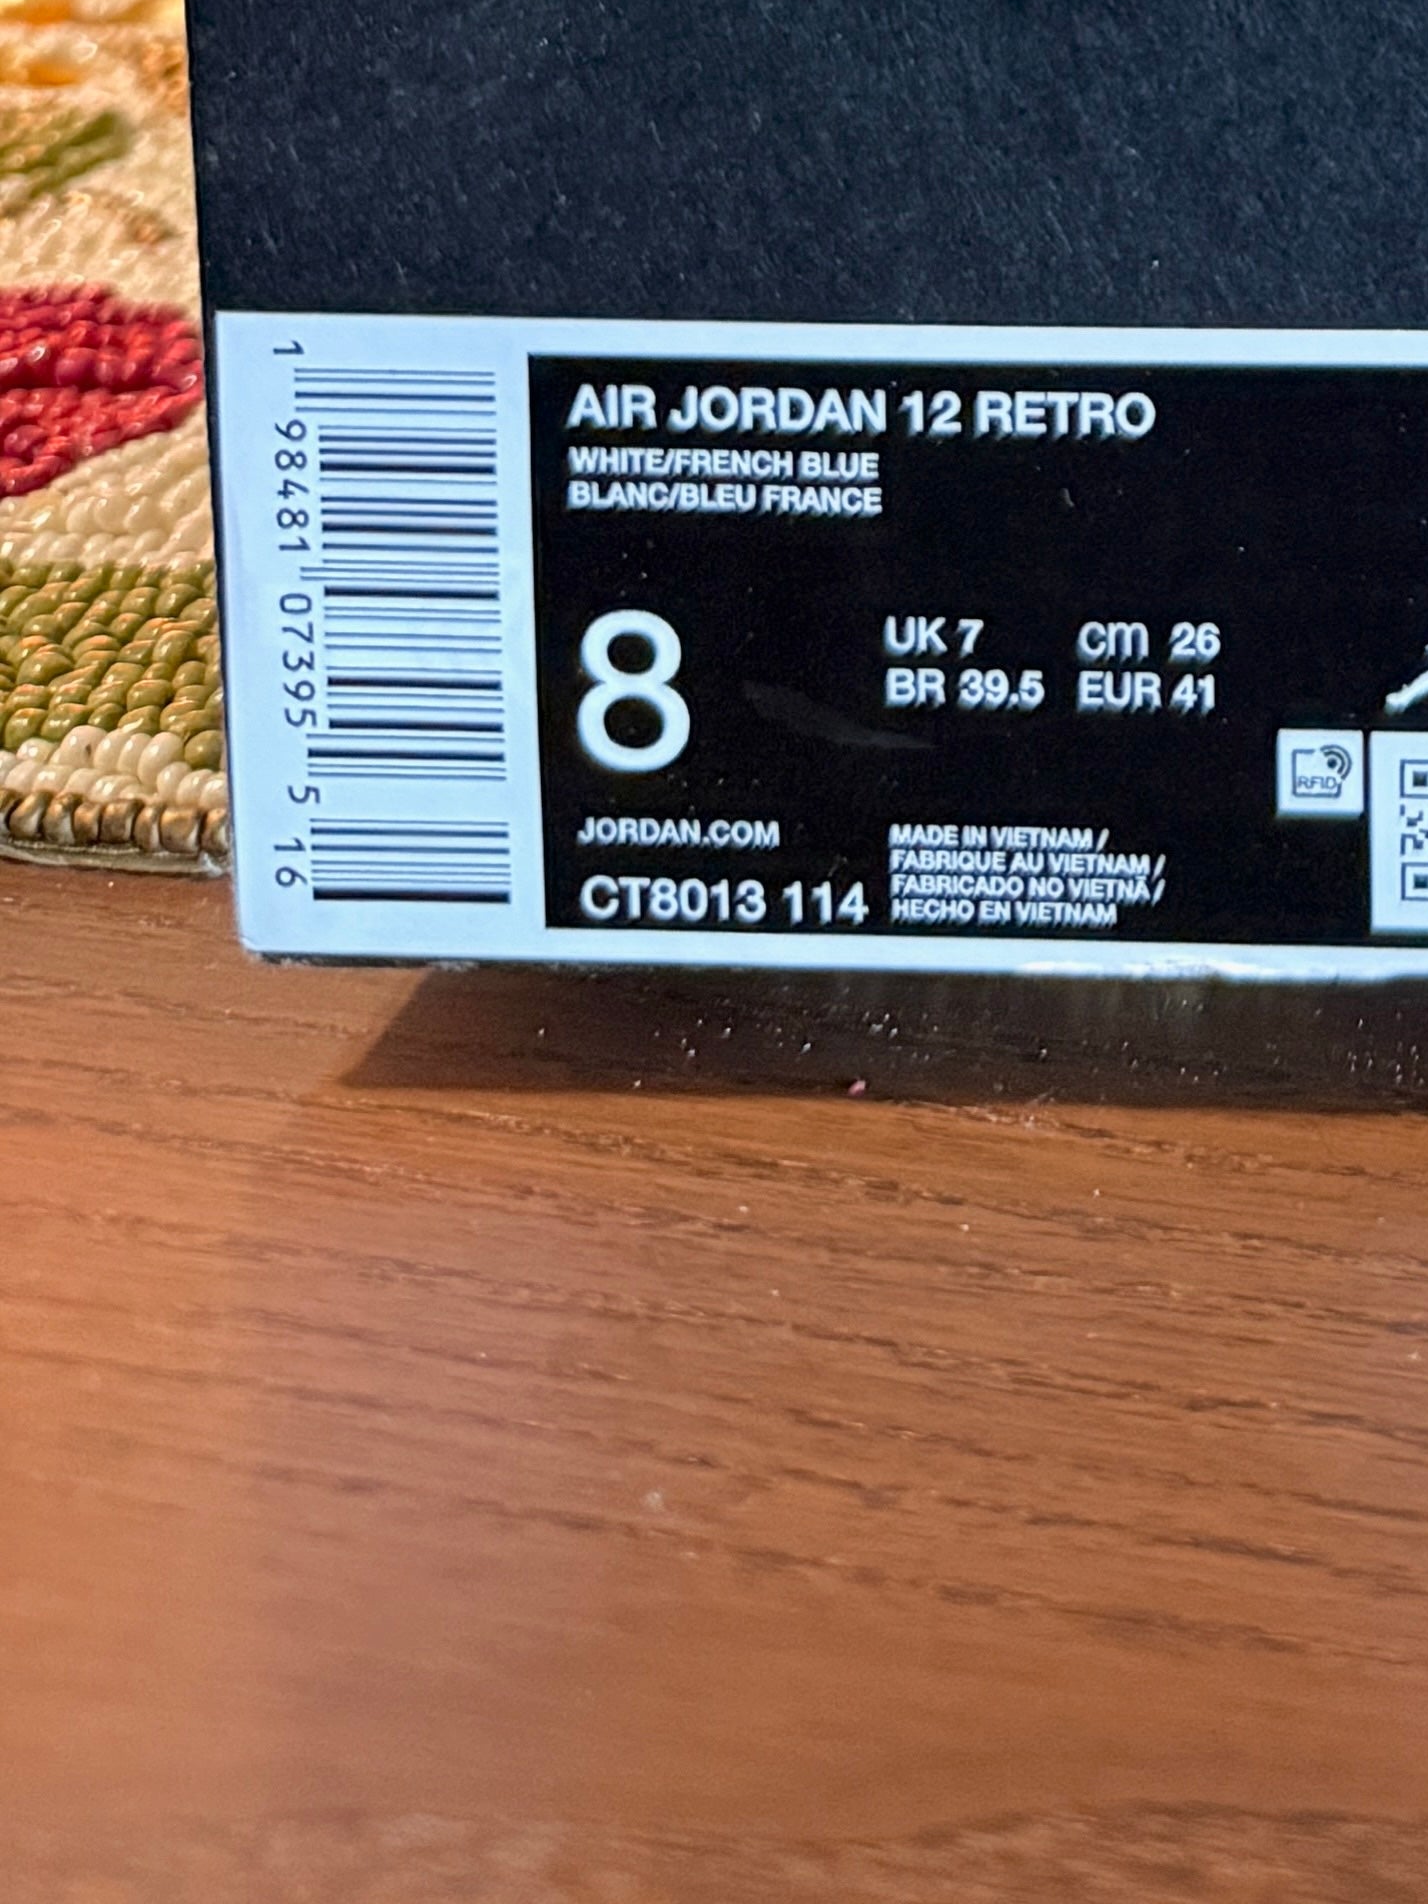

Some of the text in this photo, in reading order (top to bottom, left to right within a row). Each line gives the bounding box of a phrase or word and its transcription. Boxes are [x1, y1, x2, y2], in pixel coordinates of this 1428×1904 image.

[565, 383, 1157, 440] AIR JORDAN 12 RETRO
[567, 446, 880, 481] WHITE/FRENCH BLUE
[566, 480, 883, 517] BLANC/BLEU FRANCE
[272, 339, 322, 807] 1 98481 07395 5
[883, 615, 984, 658] UK 7
[1169, 621, 1221, 664] 26
[576, 608, 691, 775] 8
[884, 667, 1045, 710] BR 39.5
[1076, 670, 1216, 716] EUR 41
[1297, 775, 1338, 790] RFID
[577, 816, 780, 849] JORDAN.COM
[889, 824, 959, 848] MADE
[961, 825, 987, 849] IN
[990, 826, 1093, 851] VIETNAM
[272, 837, 309, 890] 16
[889, 850, 1006, 874] FABRIQUE
[1008, 852, 1044, 875] AU
[1047, 853, 1150, 876] VIETNAM
[579, 874, 870, 926] CT8013 114
[889, 874, 1024, 898] FABRICADO
[1026, 876, 1065, 900] NO
[891, 898, 1117, 929] HECHO EN VIETNAM
